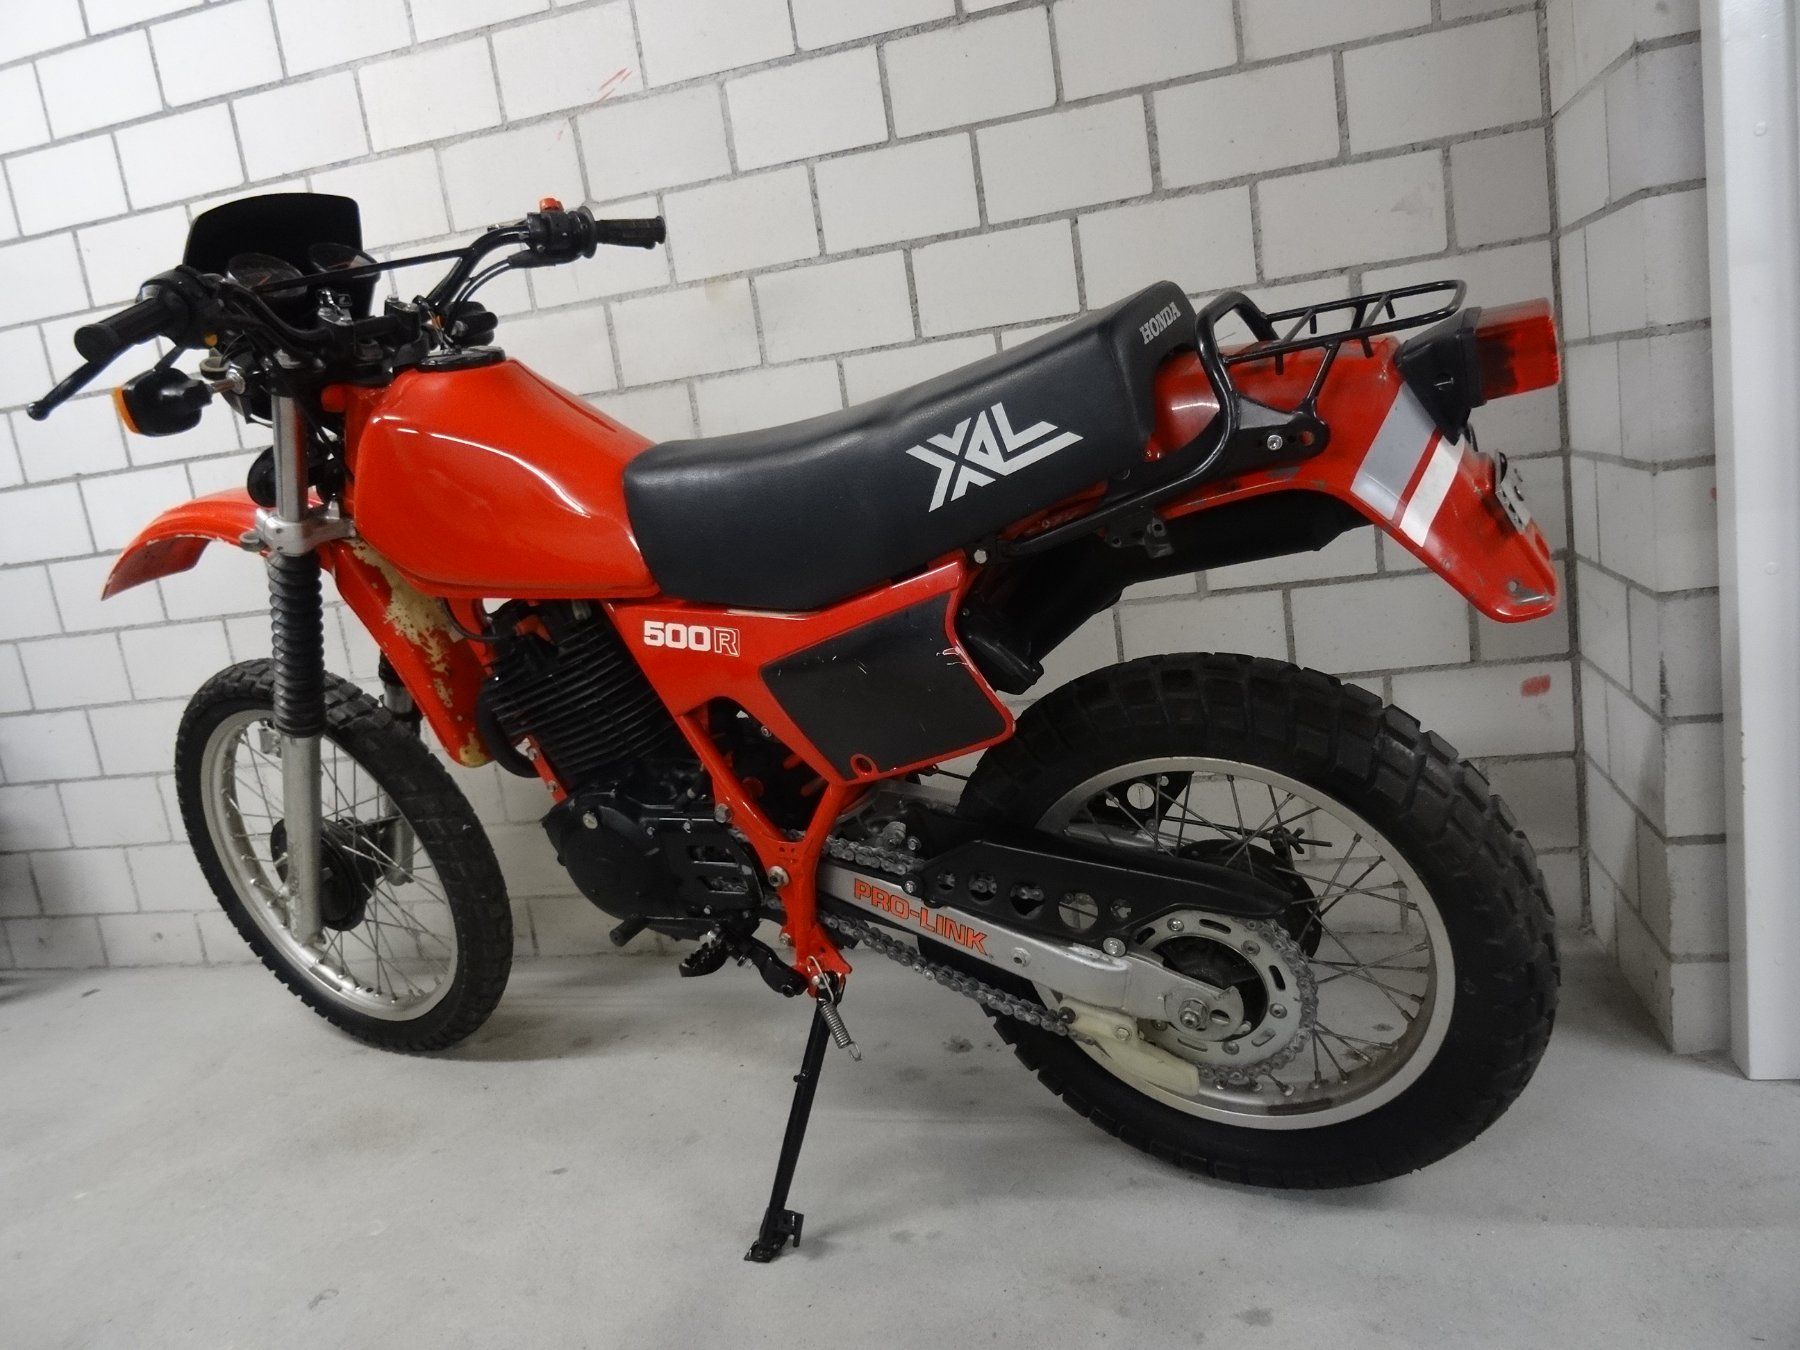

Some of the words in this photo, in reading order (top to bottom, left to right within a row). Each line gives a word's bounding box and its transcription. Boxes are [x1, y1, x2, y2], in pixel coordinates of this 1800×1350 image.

[1139, 301, 1181, 344] HONDA
[643, 620, 740, 657] 500R
[854, 878, 988, 956] PRO-LINK
